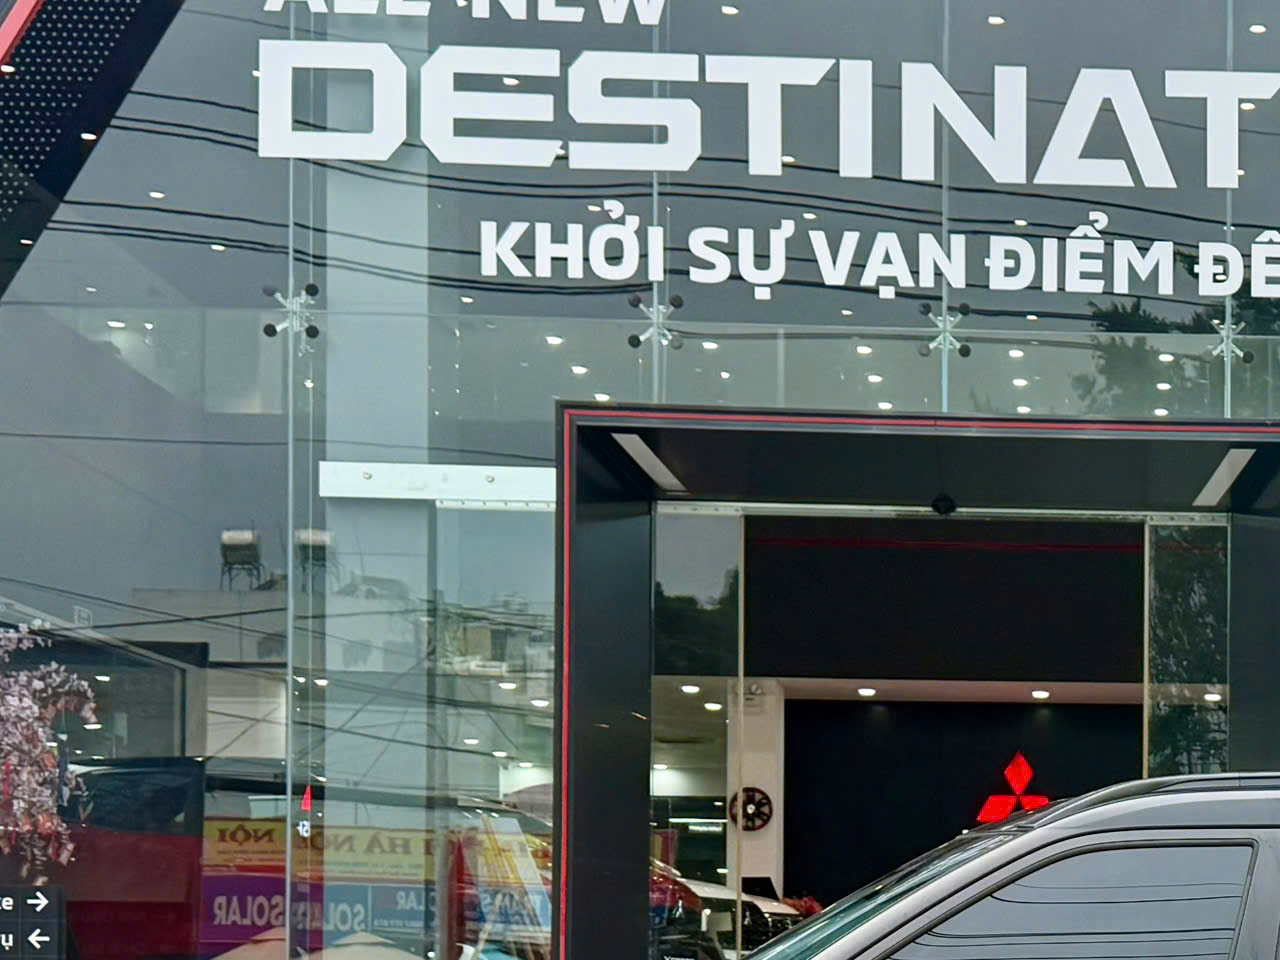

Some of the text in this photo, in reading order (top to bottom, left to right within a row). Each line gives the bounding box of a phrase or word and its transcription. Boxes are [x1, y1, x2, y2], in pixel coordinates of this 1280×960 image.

[480, 199, 665, 281] KHỞI
[688, 219, 795, 300] SỰ
[808, 229, 966, 299] VẠN
[985, 211, 1174, 295] ĐIỂM
